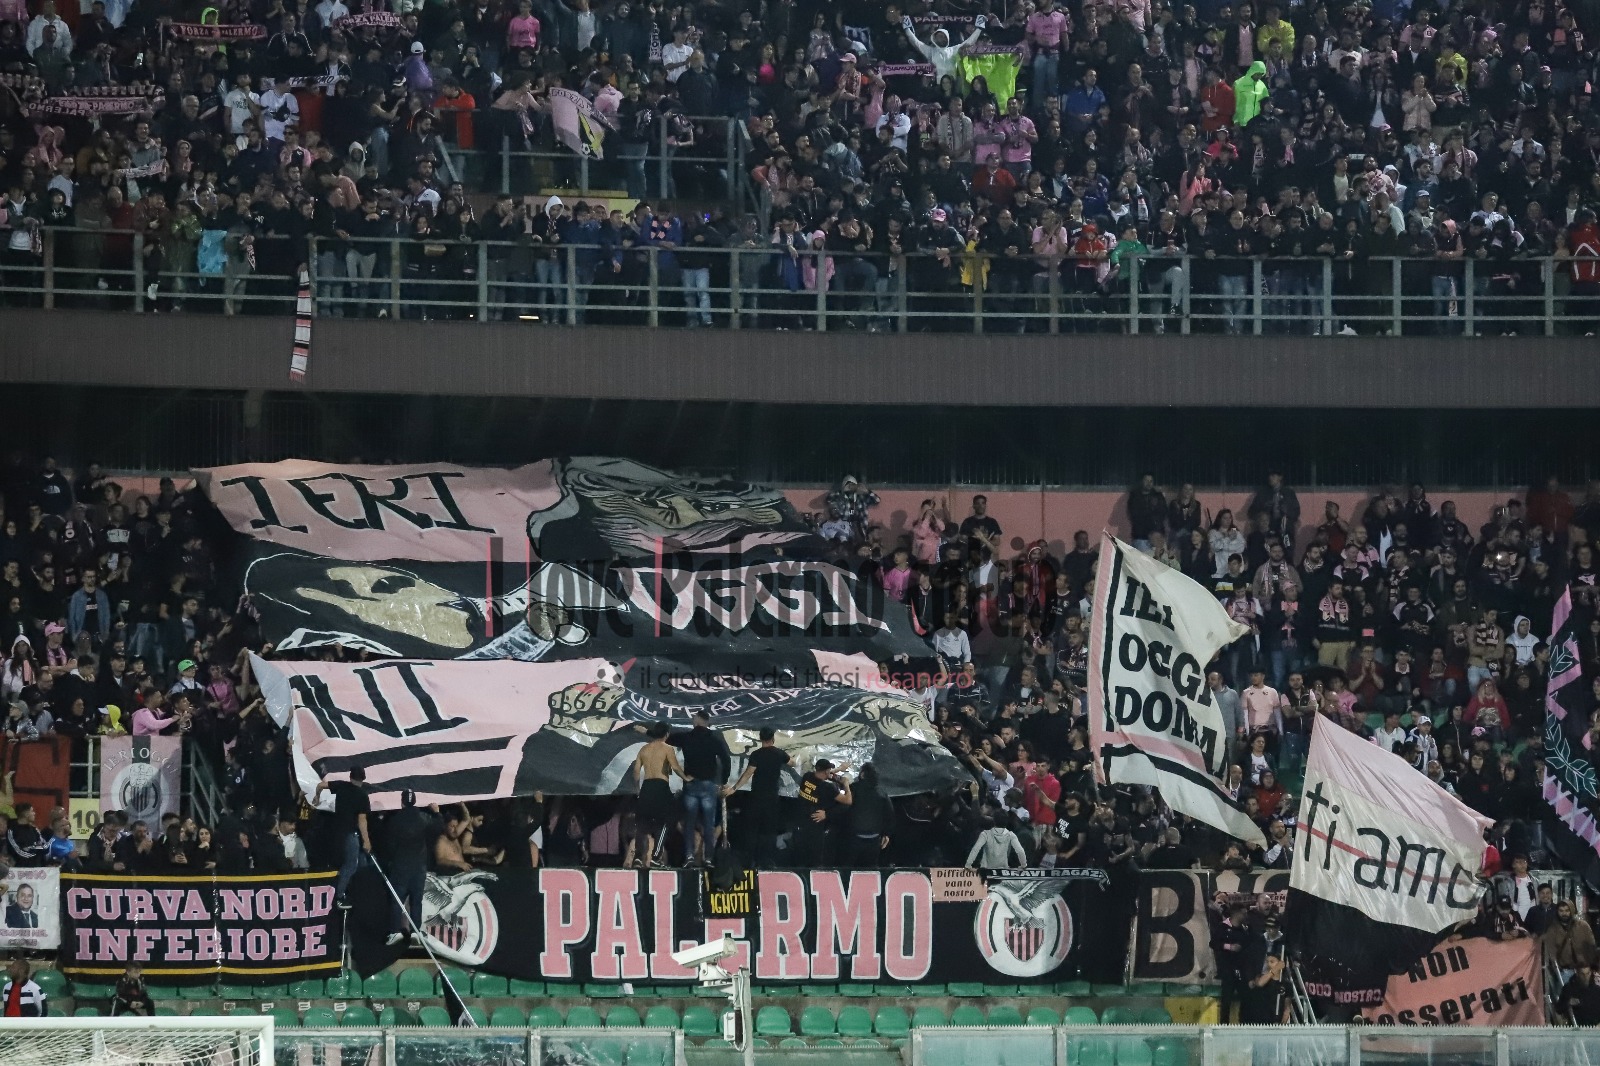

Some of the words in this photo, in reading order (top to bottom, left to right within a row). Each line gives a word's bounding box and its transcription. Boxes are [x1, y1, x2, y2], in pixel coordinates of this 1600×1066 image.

[914, 15, 973, 23] PALERMO
[220, 472, 496, 534] IERI
[616, 561, 892, 633] OGGI
[73, 810, 100, 829] 10
[1304, 782, 1340, 870] ti
[945, 880, 973, 888] vanto
[1001, 869, 1046, 877] BRAVI
[1050, 868, 1104, 878] RAGAZ
[66, 887, 211, 920] CURVA
[219, 885, 336, 920] NORD
[710, 892, 749, 914] IGNOTI
[943, 889, 976, 898] nostro
[75, 925, 327, 961] INFERIORE
